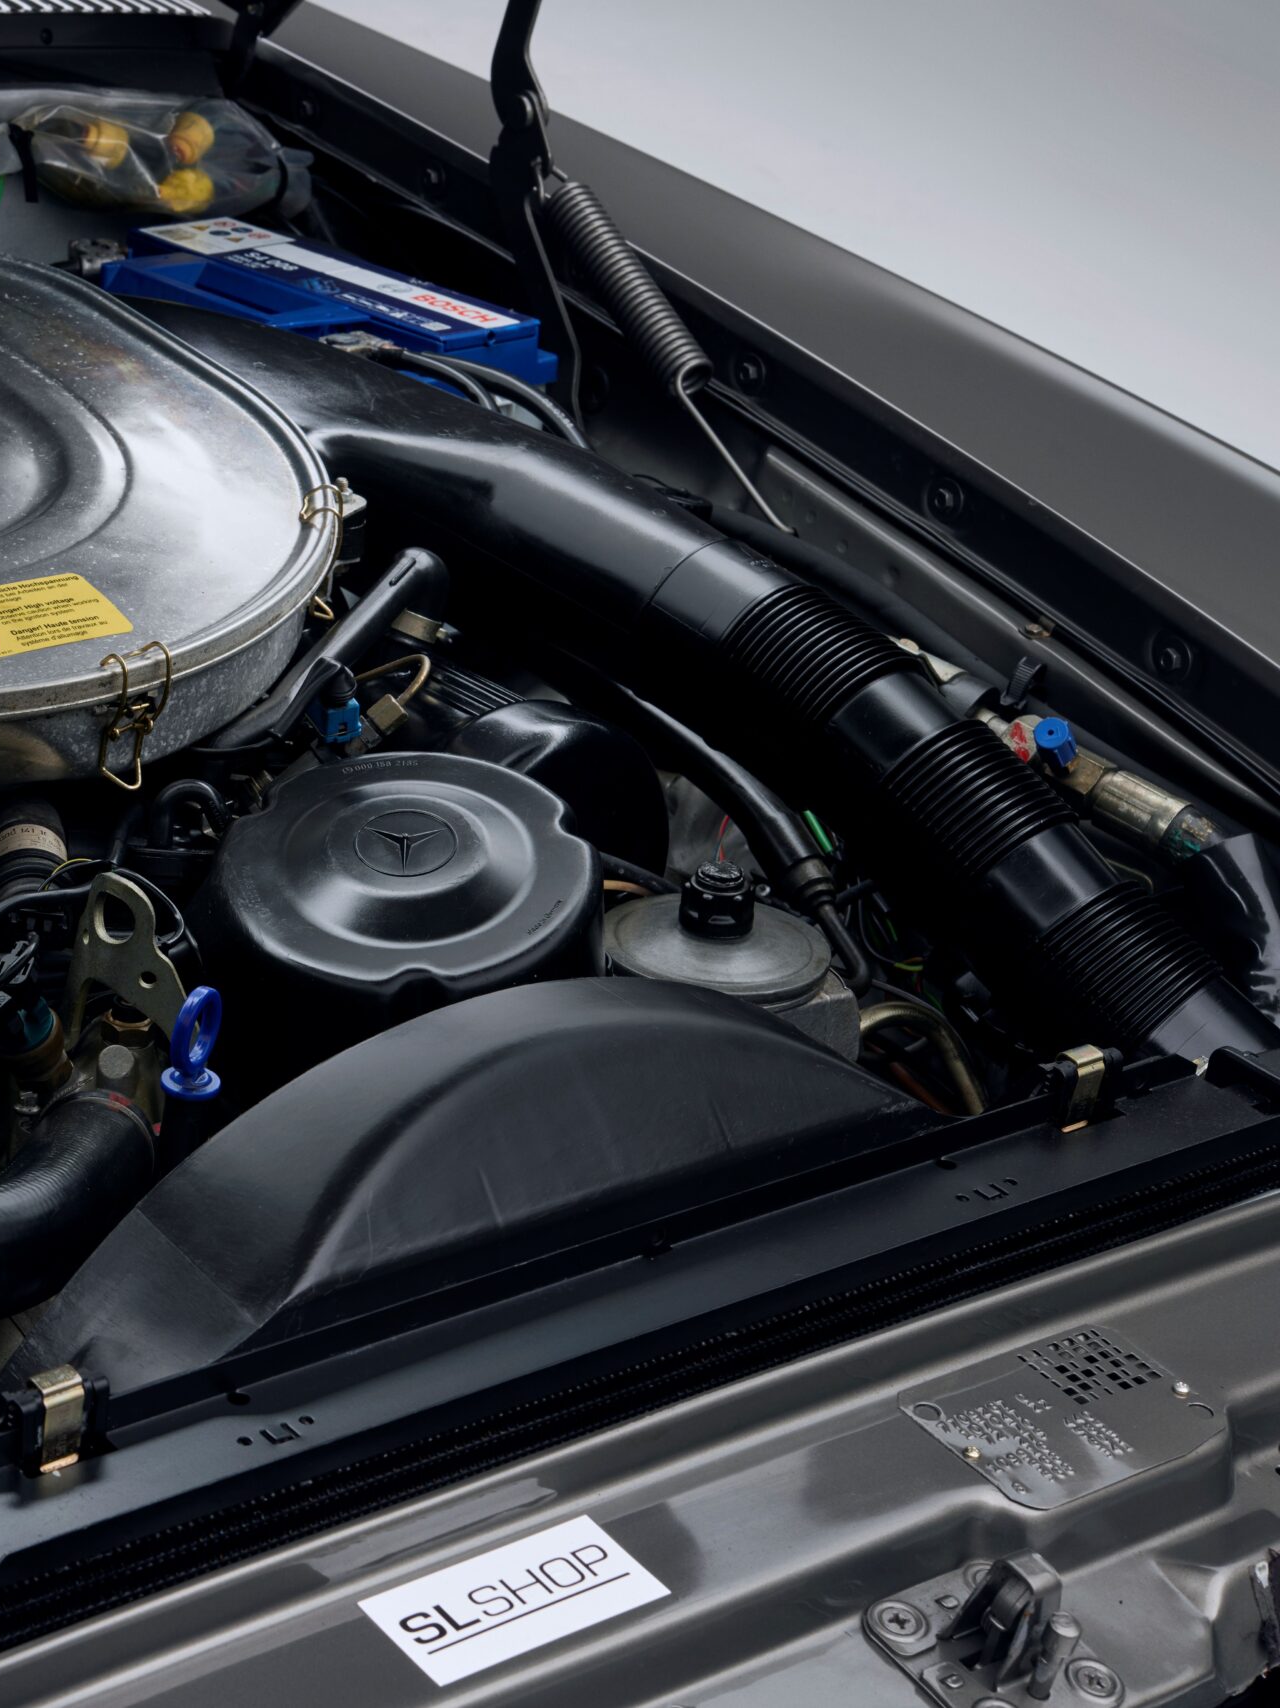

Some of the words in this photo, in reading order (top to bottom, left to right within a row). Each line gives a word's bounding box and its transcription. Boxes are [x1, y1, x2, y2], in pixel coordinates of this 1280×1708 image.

[411, 294, 498, 323] BOSCH
[17, 576, 79, 589] Hochspannung
[72, 598, 99, 606] working
[10, 625, 42, 635] Danger!
[43, 621, 68, 629] Haute
[68, 616, 99, 624] tension
[16, 632, 47, 641] Attention
[399, 1544, 608, 1645] SLSHOP
